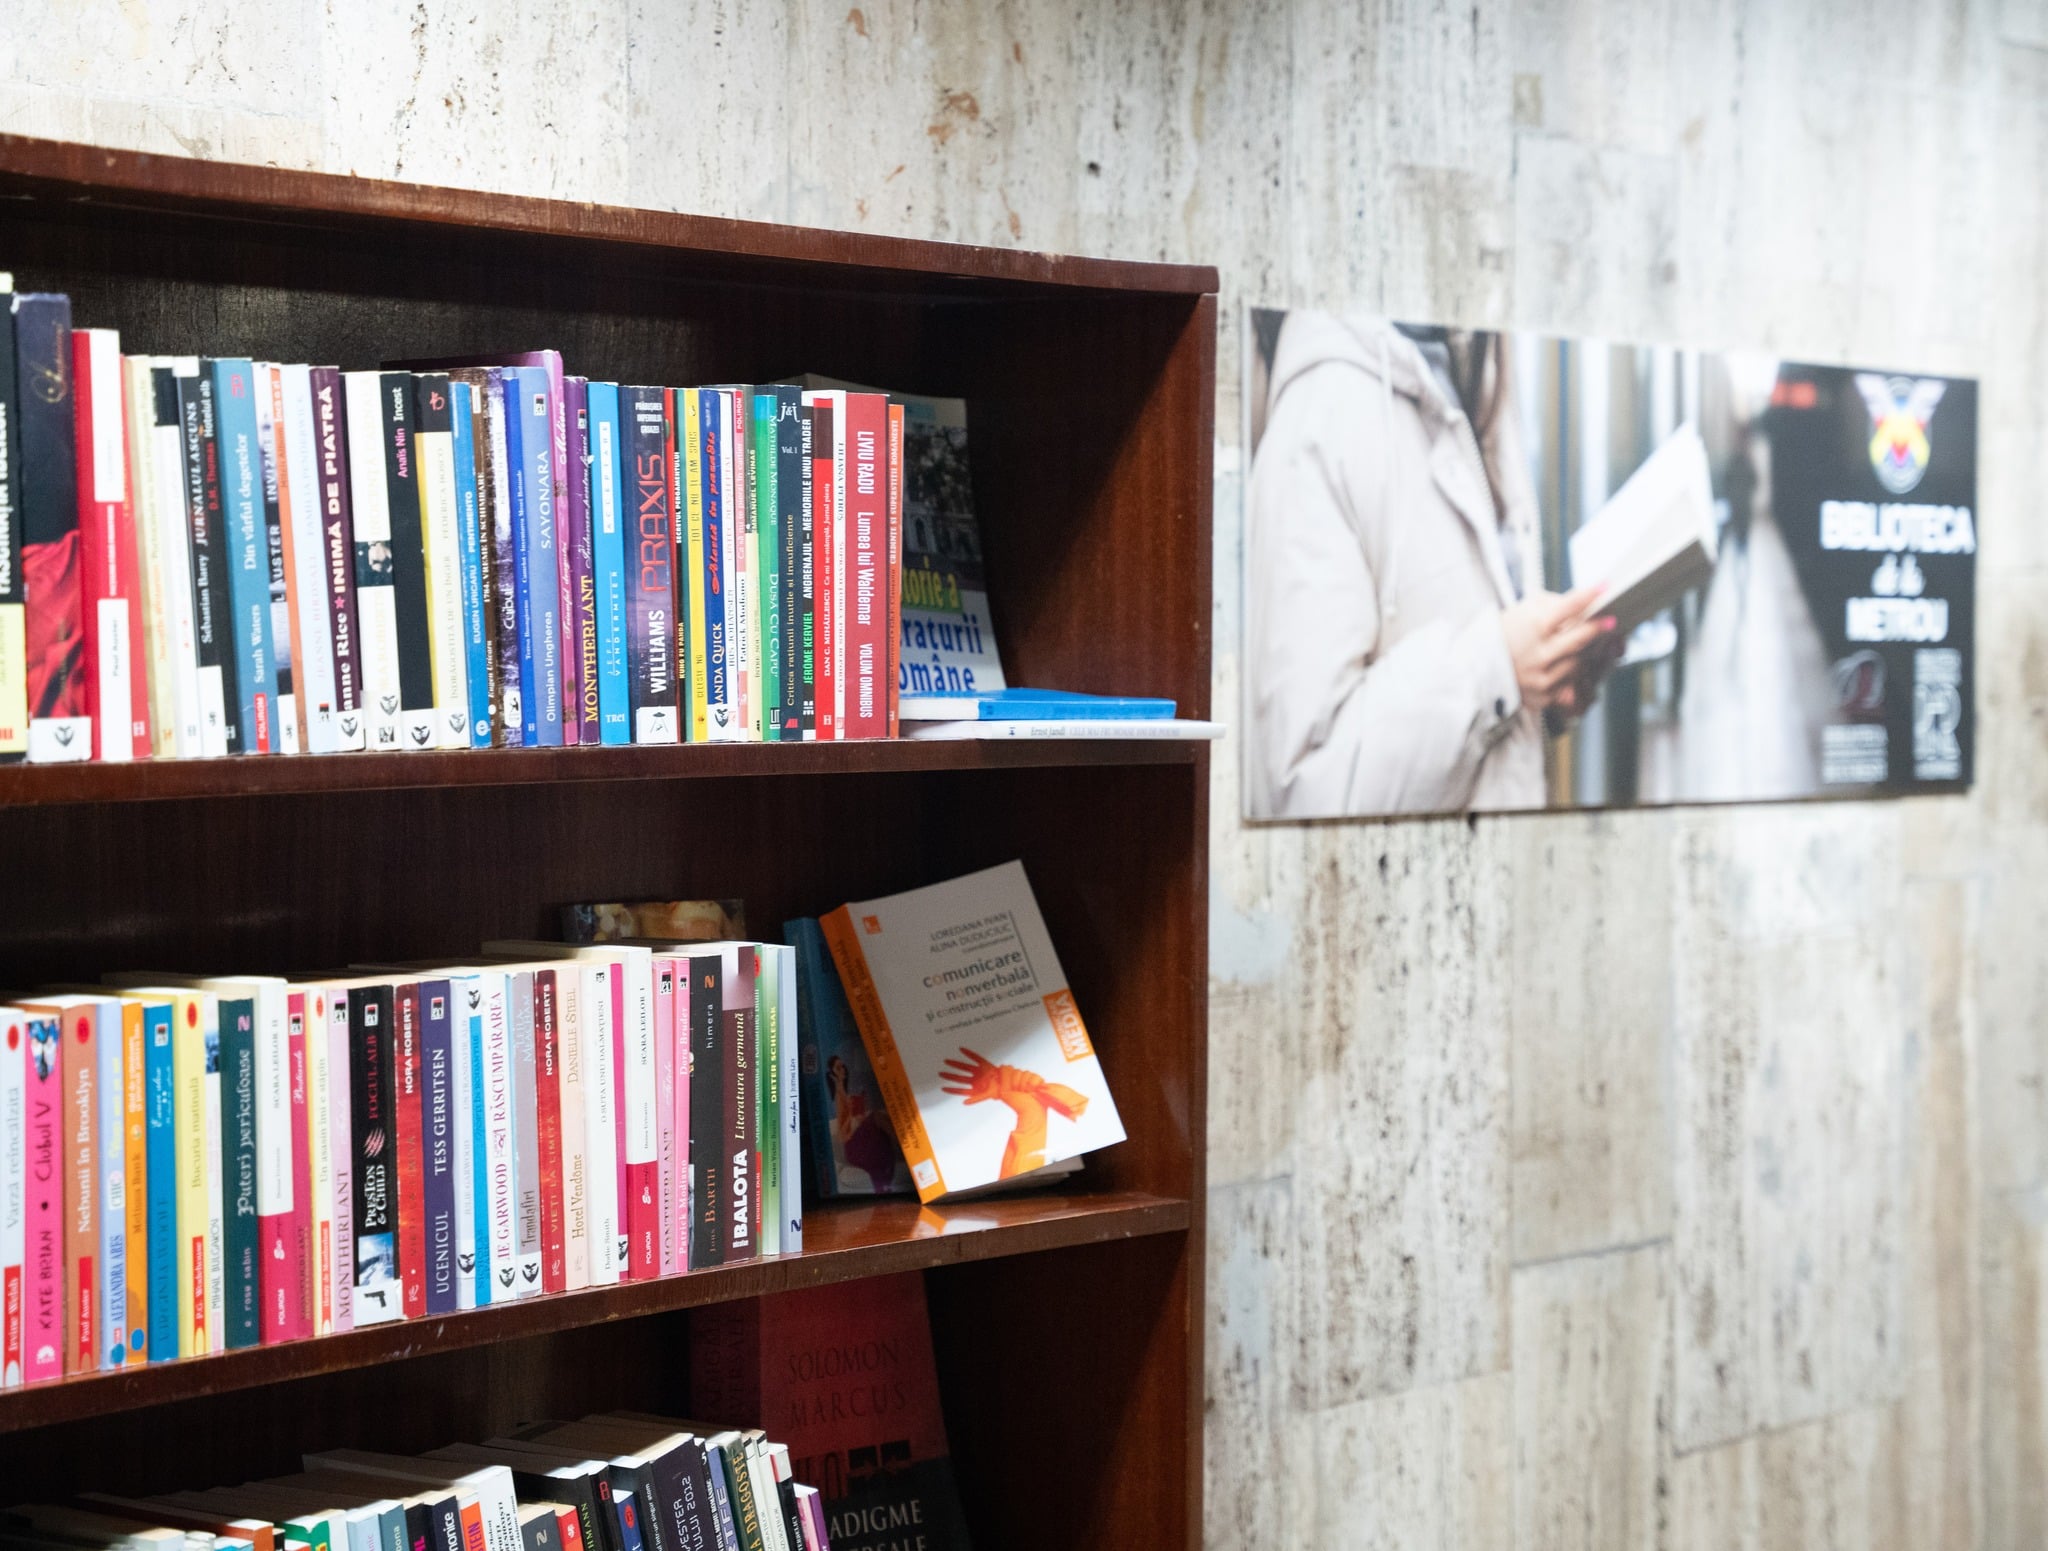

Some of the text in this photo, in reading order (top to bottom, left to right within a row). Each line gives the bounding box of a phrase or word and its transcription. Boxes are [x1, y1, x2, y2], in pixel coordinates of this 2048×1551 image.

[391, 386, 409, 478] Anaïs Nin Incest
[856, 430, 875, 495] LIVIU RADU
[186, 401, 208, 546] JURNALUL ASCUNS
[317, 385, 346, 593] INIMĂ DE PIATRĂ
[536, 449, 553, 549] SAYONARA
[748, 449, 758, 486] LEVINAS
[235, 433, 258, 570] Din vârful degetelor
[464, 490, 477, 553] PENTIMENTO
[476, 471, 487, 530] SCHIMBARE
[637, 453, 667, 593] PRAXIS
[800, 418, 813, 600] ANGRENAJUL MEMORIILE UNUI TRADER
[1820, 499, 1977, 554] BIBLIOTECA
[480, 544, 490, 580] VREME
[784, 513, 795, 576] insuficiente
[856, 511, 876, 626] Lumea lui Waldemar
[196, 554, 213, 643] Sebastian Barry
[468, 565, 482, 644] EUGEN URICARU
[611, 570, 622, 677] VANDERMEER
[785, 591, 795, 626] inutile
[946, 574, 959, 609] a
[1845, 597, 1949, 642] METROU
[250, 604, 266, 683] Sarah Waters
[335, 612, 351, 657] Rice
[580, 575, 599, 723] MONTHERLANT
[648, 609, 667, 694] WILLIAMS
[676, 622, 685, 647] PANDA
[710, 622, 726, 665] QUICK
[738, 628, 748, 663] Patrick
[802, 611, 814, 648] KERVIEL
[823, 645, 832, 677] DAN C.
[542, 611, 557, 722] Olimpian Ungherea
[677, 658, 686, 679] KUNG
[786, 670, 796, 706] Critica
[858, 643, 874, 718] VOLUM OMNIBUS
[929, 912, 1009, 942] LOREDANA IVAN
[929, 938, 959, 955] ALINA
[922, 949, 1023, 990] comunicare
[945, 966, 1031, 1002] nonverbală
[402, 997, 414, 1095] NORA ROBERTS
[543, 983, 554, 1077] NORA ROBERTS
[565, 987, 580, 1084] DANIELLE STEEL
[639, 995, 648, 1032] LEILOR
[678, 1007, 689, 1045] Bruder
[705, 1003, 714, 1050] himera
[1054, 993, 1090, 1056] MEDIA
[733, 1011, 747, 1141] Literatura germană
[768, 1005, 778, 1104] DIETER SCHLESAK
[35, 1101, 52, 1183] Clubul V
[236, 1049, 256, 1217] Puteri periculoase
[432, 1048, 448, 1176] TESS GERRITSEN
[75, 1067, 92, 1234] Nebunii în Brooklyn
[131, 1152, 143, 1187] Bank
[548, 1170, 558, 1188] LA
[363, 1164, 378, 1228] PRESTON
[375, 1164, 387, 1225] & CHILD
[494, 1163, 510, 1241] GARWOOD
[570, 1153, 585, 1240] Hotel Vendôme
[678, 1159, 688, 1256] Patrick Modiano
[703, 1167, 716, 1224] BARTH
[731, 1148, 748, 1240] BALOTĂ
[193, 1240, 203, 1297] Wodehouse
[209, 1217, 221, 1311] MIHAIL BULGAKOV
[335, 1168, 352, 1320] MONTHERLANT
[434, 1210, 450, 1294] UCENICUL
[38, 1230, 54, 1330] KATE BRIAN
[109, 1233, 125, 1323] ALEXANDRA ARES
[241, 1247, 252, 1312] rose sabin
[6, 1277, 19, 1352] Irvine Welsh
[81, 1288, 91, 1343] Paul Auster
[786, 1338, 900, 1386] SOLOMON
[789, 1381, 907, 1430] MARCUS
[648, 1501, 658, 1522] singur
[682, 1475, 697, 1510] 2012
[731, 1451, 758, 1535] DRAGOSTE
[830, 1497, 924, 1541] ADIGME
